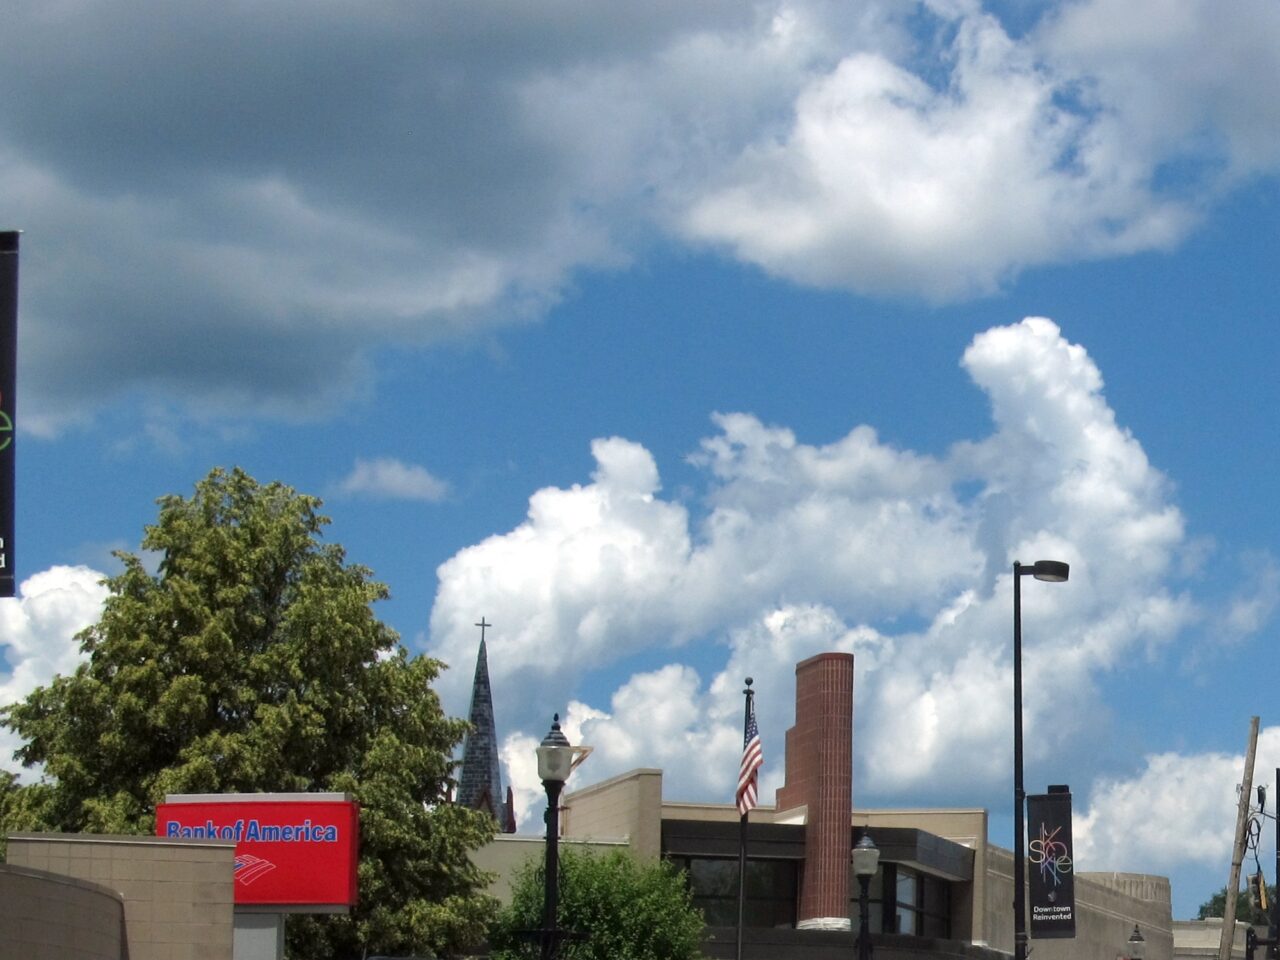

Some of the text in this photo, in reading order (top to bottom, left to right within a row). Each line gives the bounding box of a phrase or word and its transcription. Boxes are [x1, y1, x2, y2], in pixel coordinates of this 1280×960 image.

[166, 819, 337, 842] Bank of America
[1033, 906, 1071, 914] Downtown
[1032, 913, 1072, 921] Reinvented
